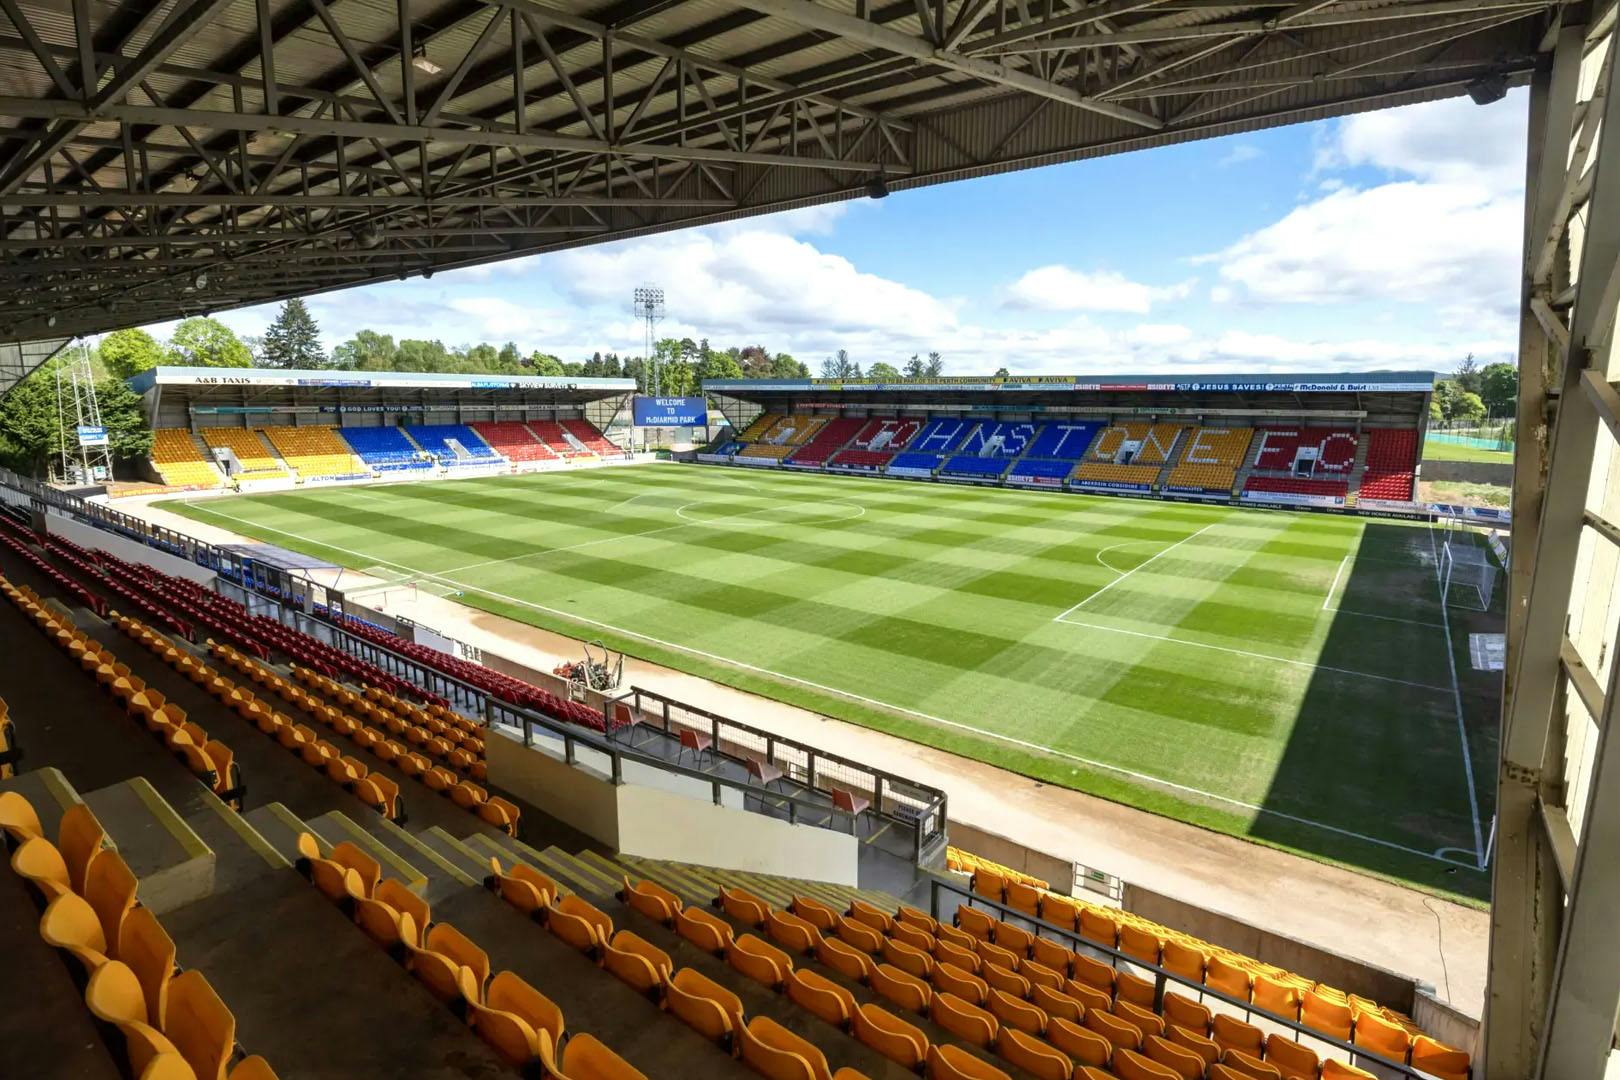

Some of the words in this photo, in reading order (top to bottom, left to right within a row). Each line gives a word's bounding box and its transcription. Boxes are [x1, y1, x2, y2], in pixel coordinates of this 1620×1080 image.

[195, 376, 218, 384] A&B
[680, 416, 696, 424] PARK
[1254, 431, 1358, 470] FC
